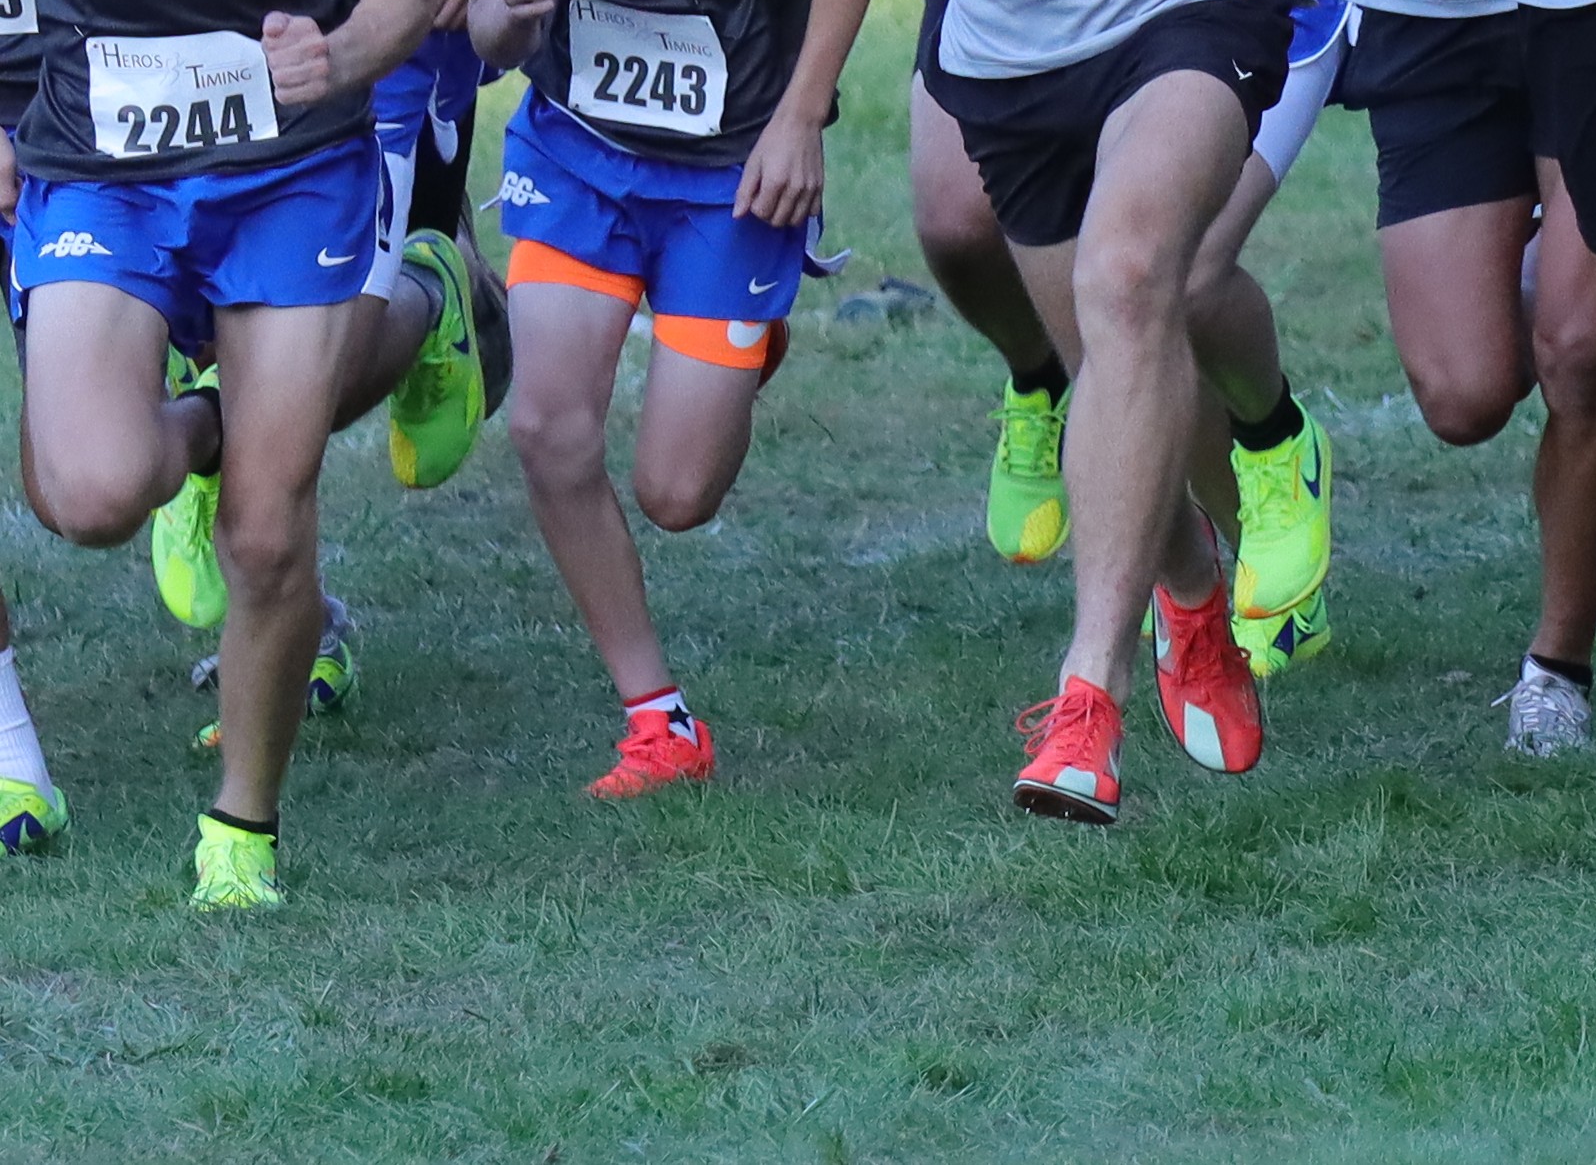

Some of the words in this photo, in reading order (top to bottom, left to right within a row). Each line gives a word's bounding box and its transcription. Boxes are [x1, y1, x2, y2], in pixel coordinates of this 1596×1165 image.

[655, 31, 713, 57] TIMING
[185, 64, 252, 89] TIMING
[593, 51, 708, 116] 2243
[117, 93, 253, 153] 2244
